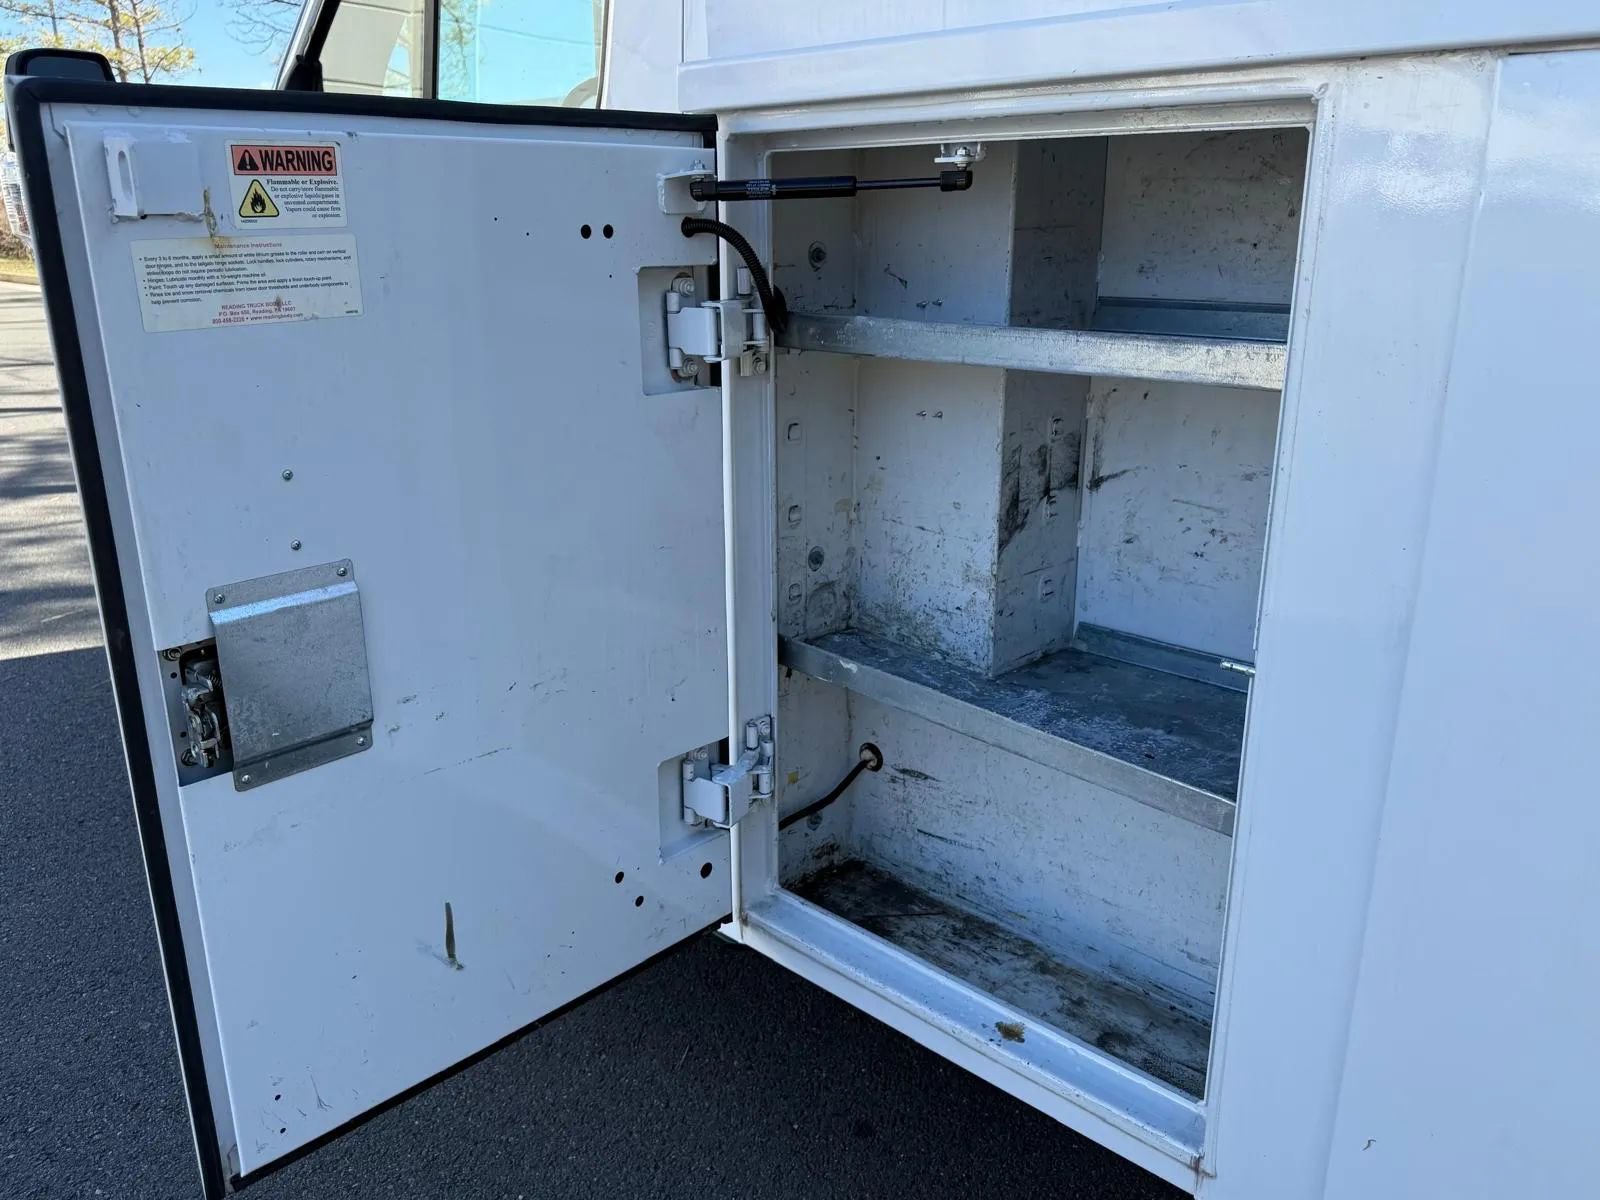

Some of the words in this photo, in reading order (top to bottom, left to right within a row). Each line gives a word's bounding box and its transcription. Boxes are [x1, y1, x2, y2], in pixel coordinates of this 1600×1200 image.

[259, 149, 334, 172] WARNING
[309, 178, 338, 186] Explosive.
[250, 312, 304, 320] www.readingbody.com
